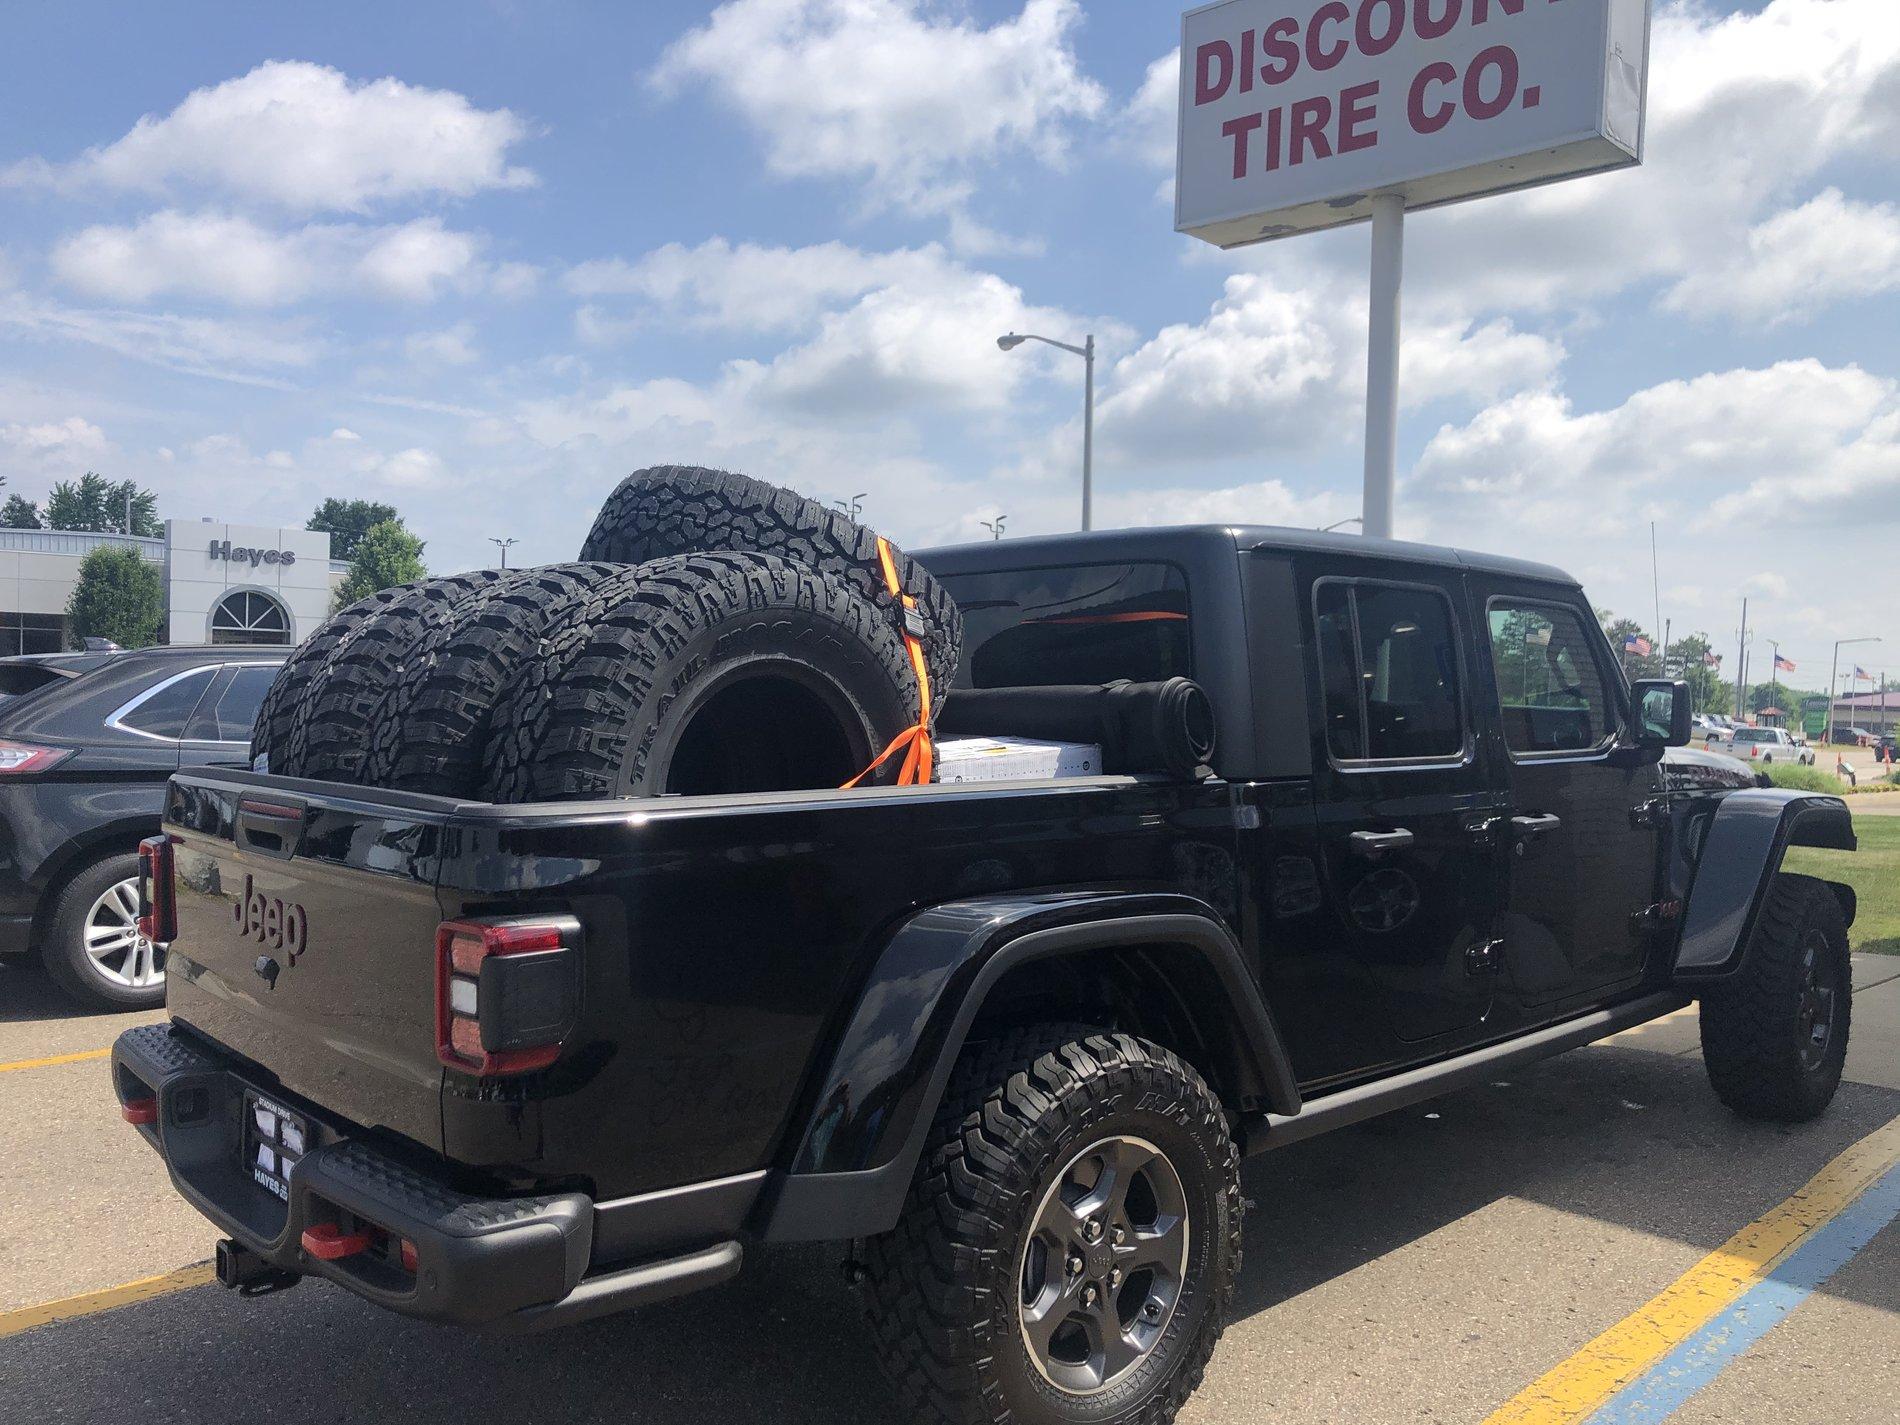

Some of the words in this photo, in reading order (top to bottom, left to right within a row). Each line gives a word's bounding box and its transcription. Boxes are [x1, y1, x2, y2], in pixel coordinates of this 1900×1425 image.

[1195, 0, 1563, 106] DISCOU
[1222, 81, 1379, 179] TIRE
[1407, 45, 1541, 134] CO.
[210, 540, 296, 568] Hayes
[233, 873, 308, 967] Jeep
[258, 1096, 277, 1114] STADIUM
[277, 1106, 291, 1121] DRIVE
[254, 1168, 280, 1194] HAYES
